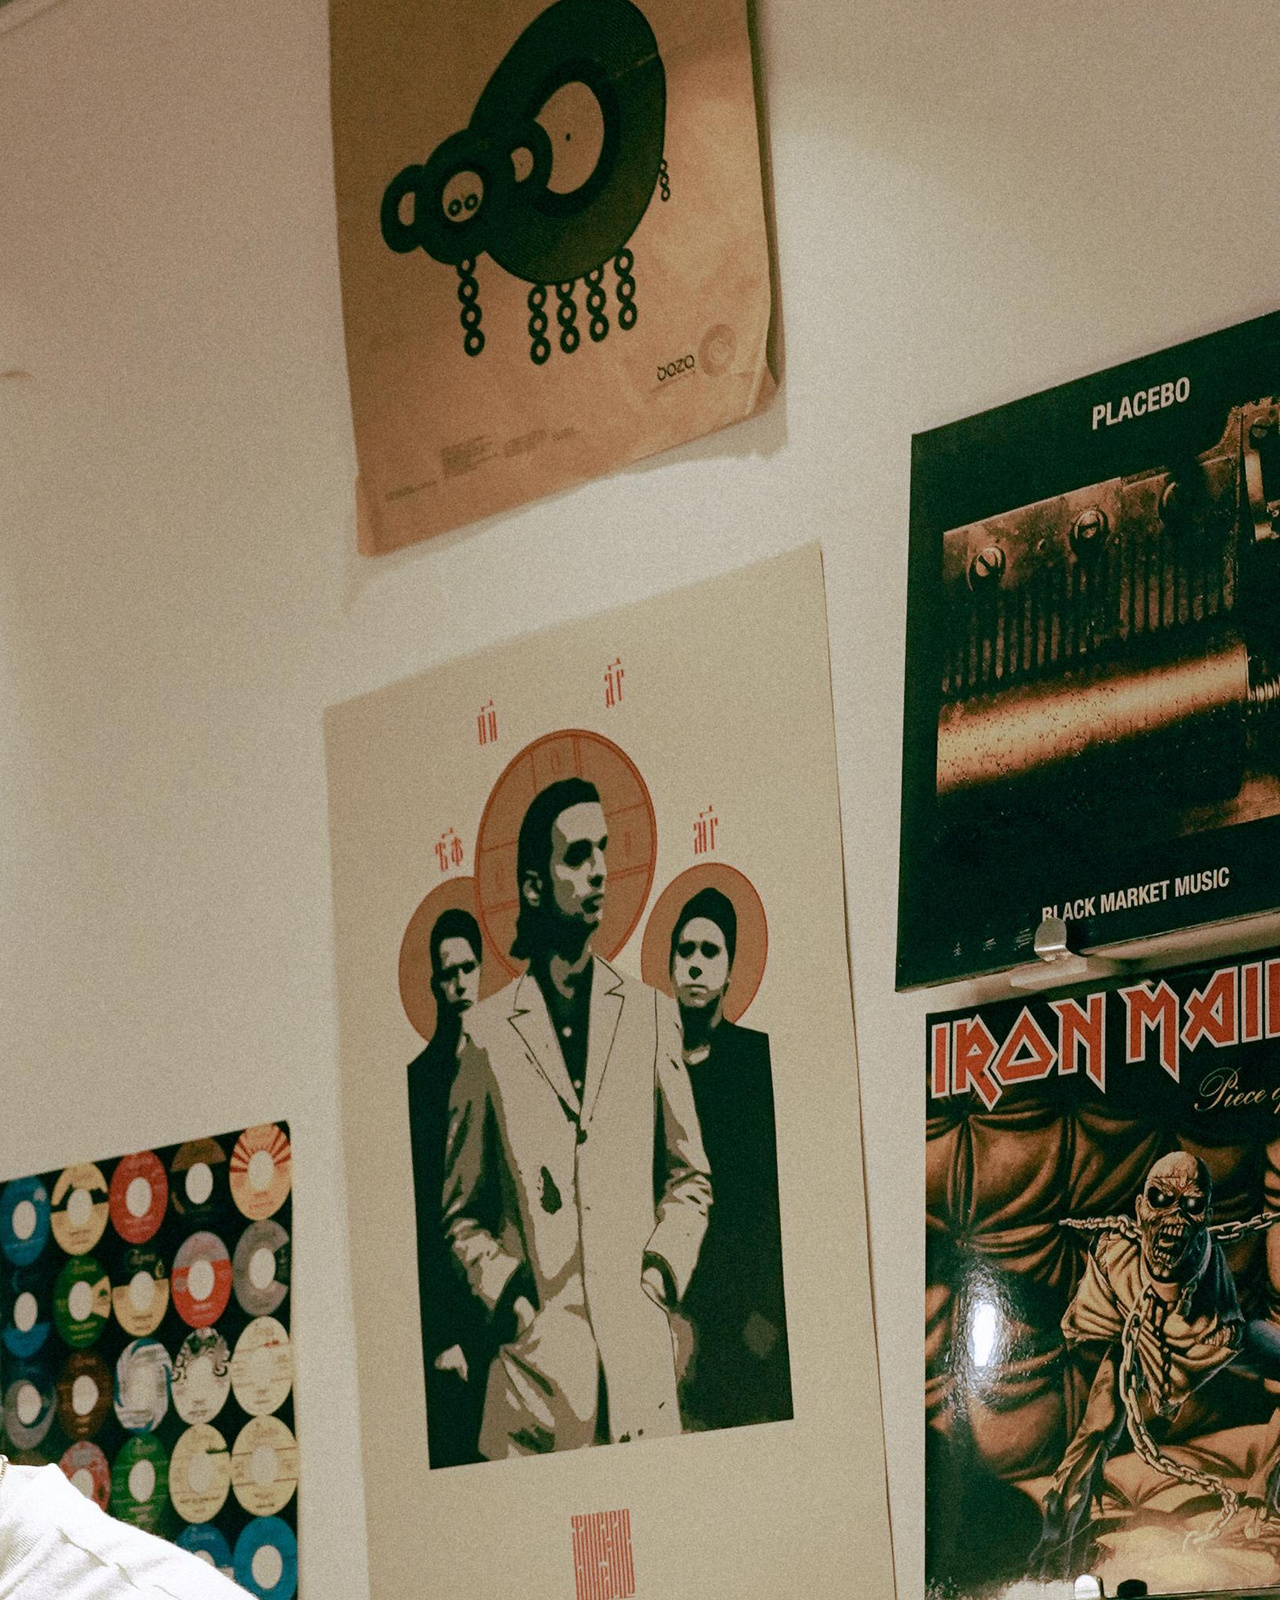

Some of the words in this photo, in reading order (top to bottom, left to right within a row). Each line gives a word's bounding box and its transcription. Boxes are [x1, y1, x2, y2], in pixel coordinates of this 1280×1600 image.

[1091, 377, 1191, 430] PLACEBO
[1041, 896, 1096, 922] BLACK
[1100, 880, 1171, 914] MARKET
[1174, 866, 1231, 899] MUSIC
[931, 991, 1106, 1112] IRON
[1193, 1066, 1267, 1112] Piece
